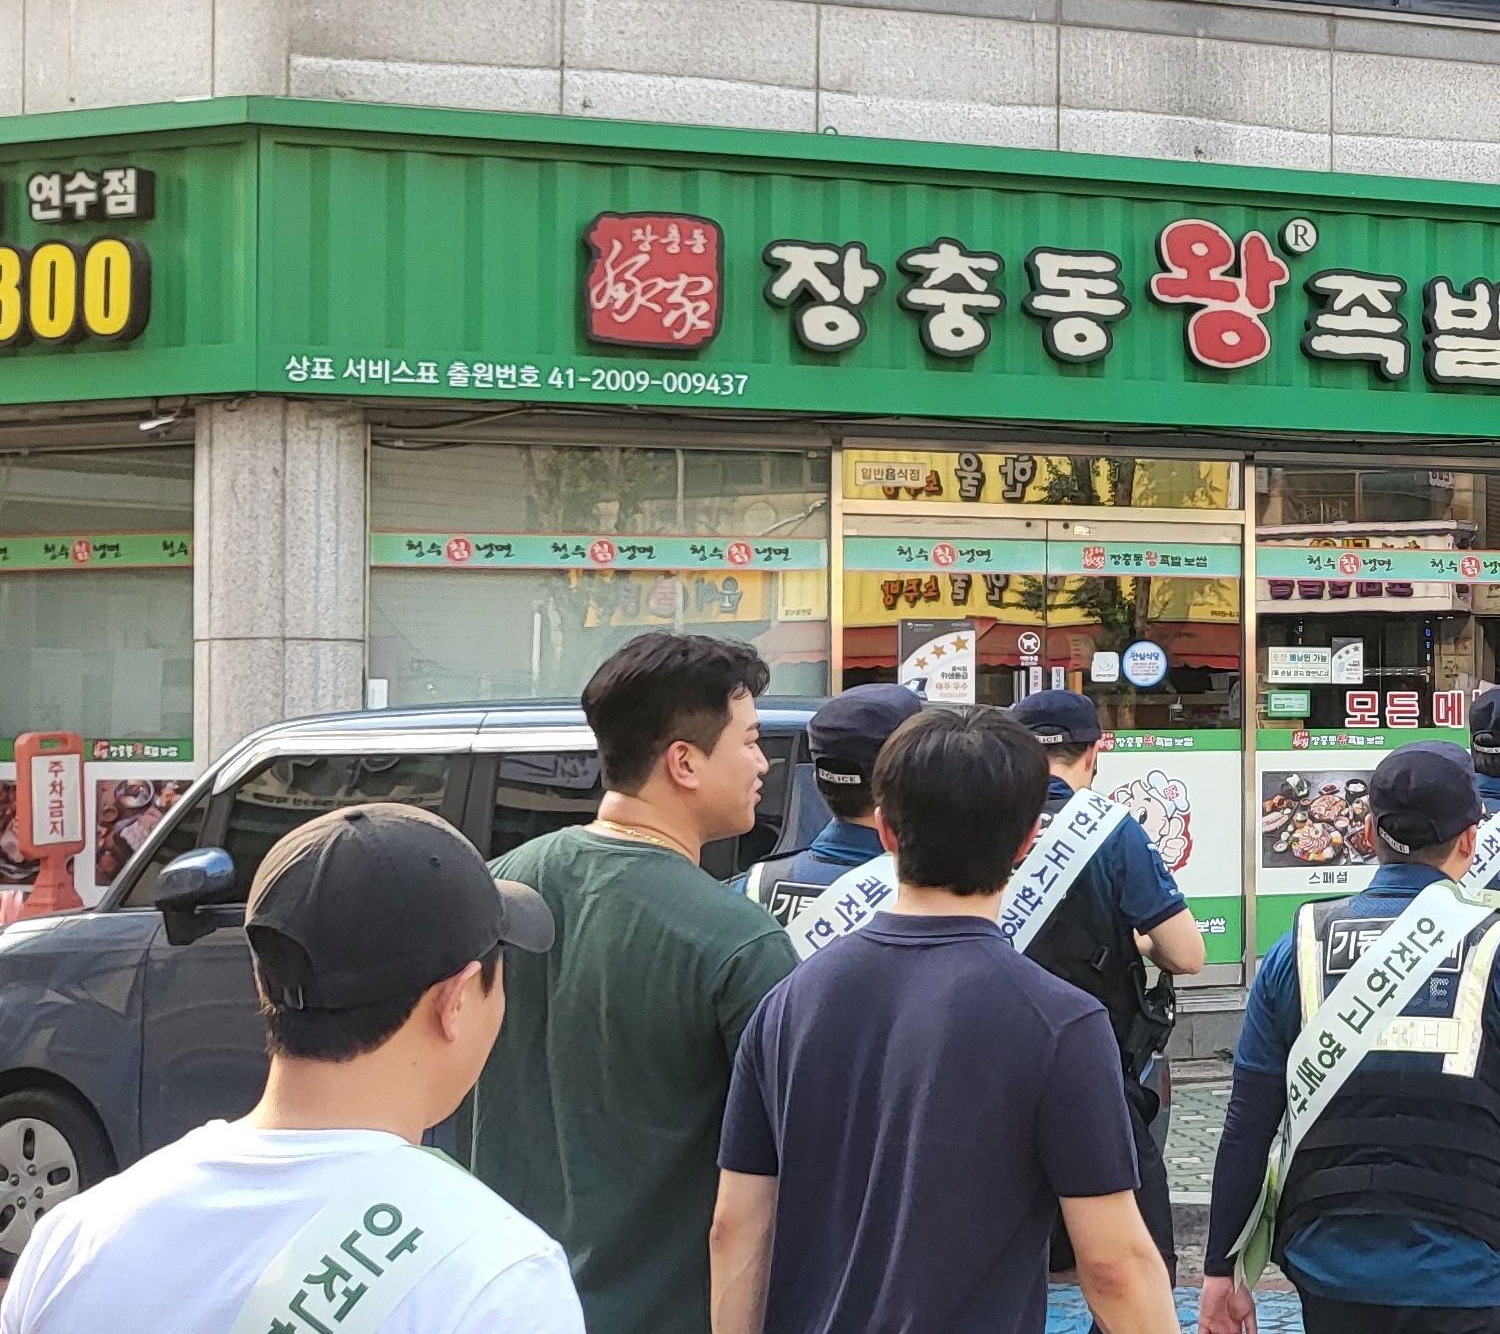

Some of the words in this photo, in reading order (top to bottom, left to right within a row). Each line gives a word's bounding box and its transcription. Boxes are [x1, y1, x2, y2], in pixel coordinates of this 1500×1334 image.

[28, 167, 138, 221] 연수점
[284, 355, 335, 382] 상표
[342, 357, 439, 386] 서비스표
[446, 361, 541, 390] 출원번호
[548, 366, 749, 396] 41-2009-009437
[860, 466, 922, 481] 일반음식점
[1345, 691, 1420, 729] 모든
[47, 760, 65, 838] 주차금지
[1337, 916, 1447, 1036] 안전하고
